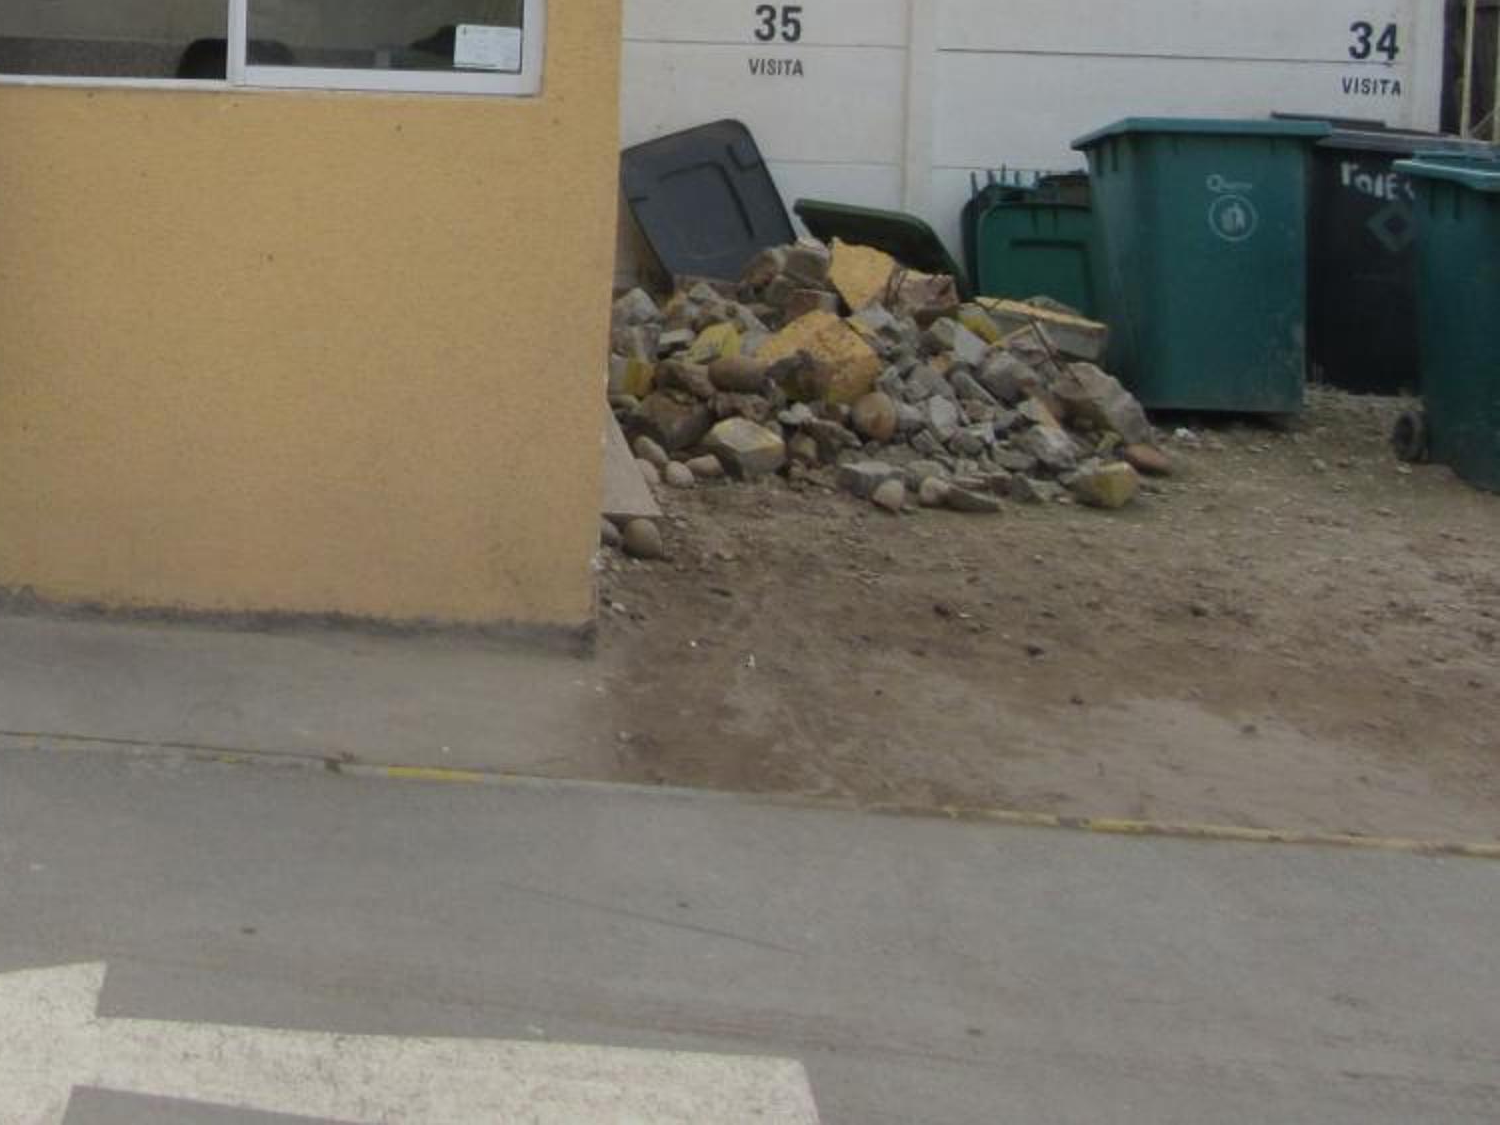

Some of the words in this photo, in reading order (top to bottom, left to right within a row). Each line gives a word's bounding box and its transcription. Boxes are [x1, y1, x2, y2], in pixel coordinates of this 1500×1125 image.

[755, 4, 803, 43] 35
[1348, 21, 1400, 62] 34
[748, 58, 804, 77] VISITA
[1341, 77, 1401, 97] VISITA
